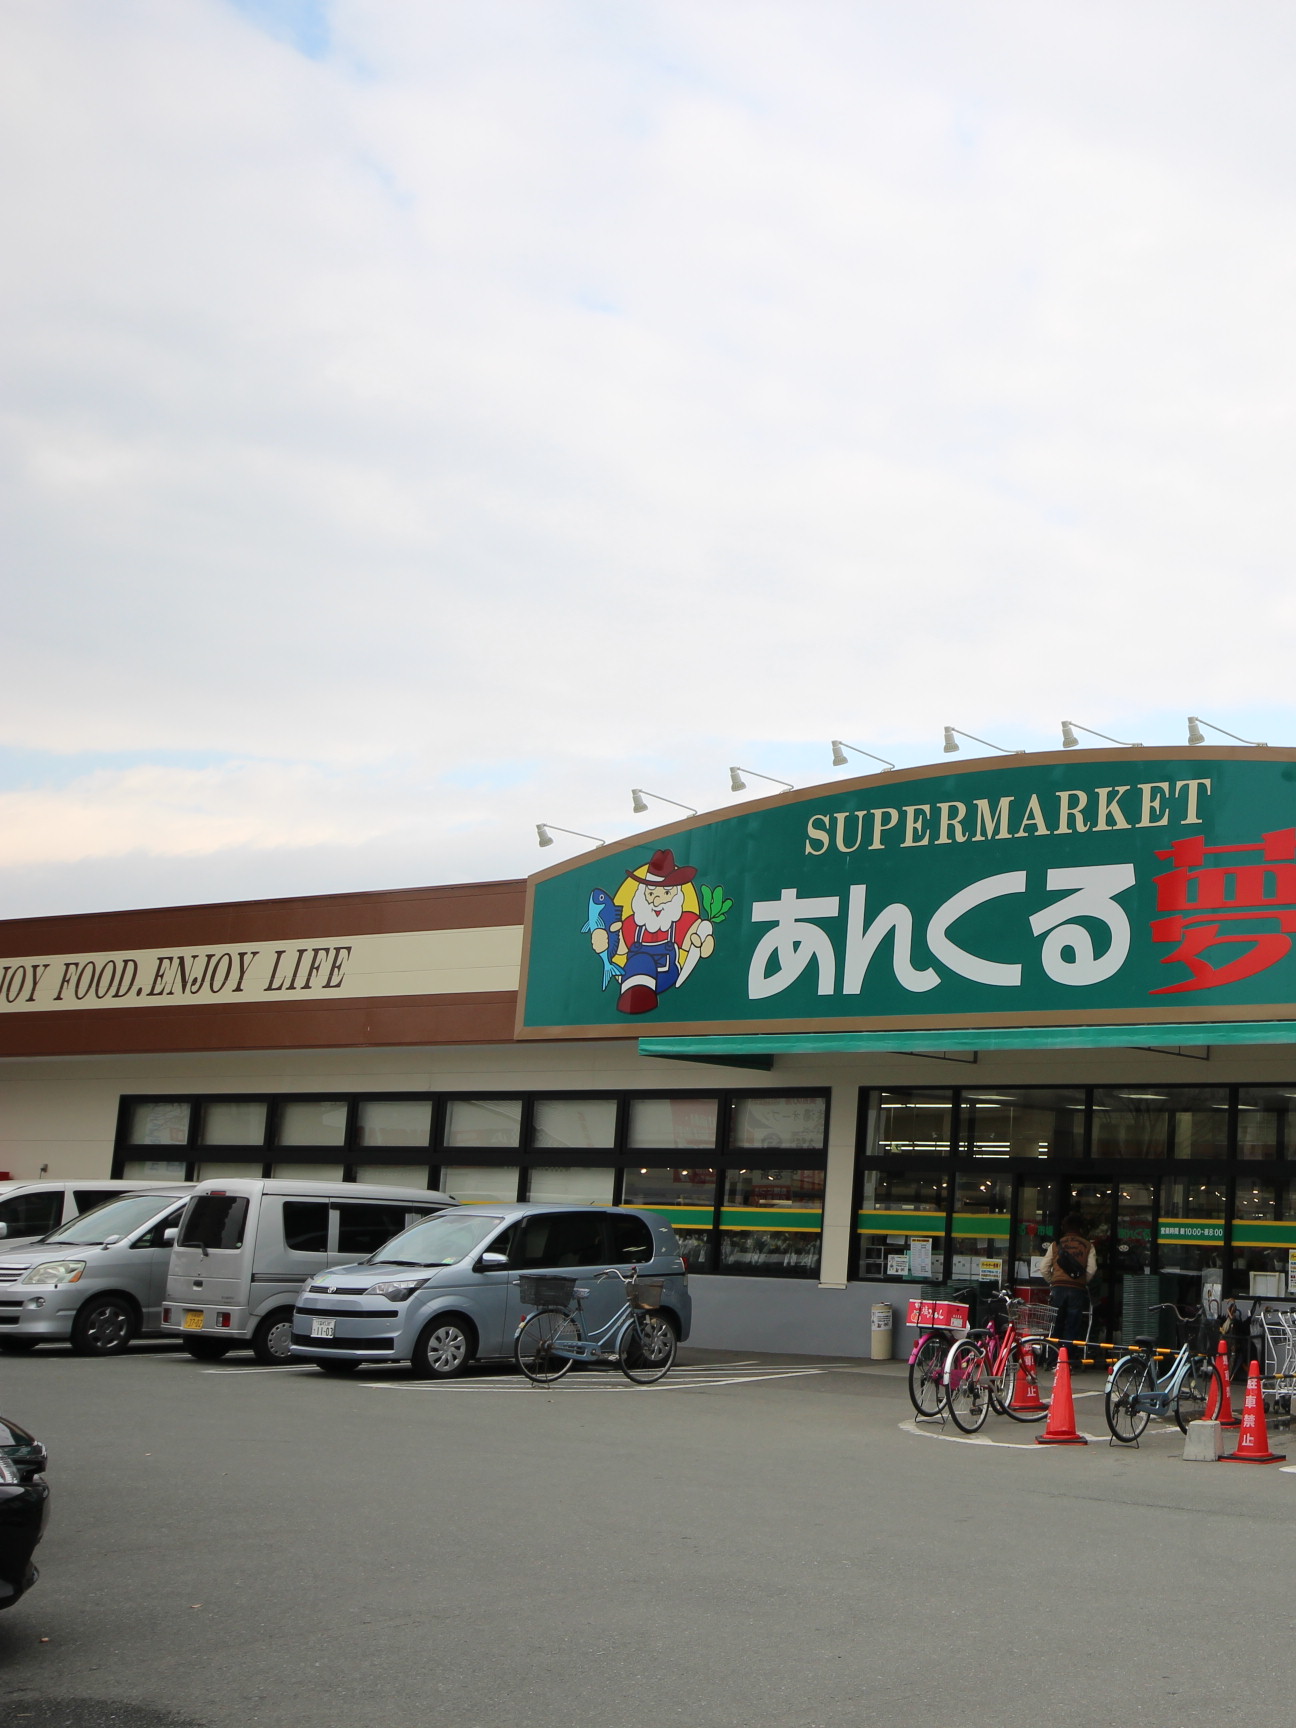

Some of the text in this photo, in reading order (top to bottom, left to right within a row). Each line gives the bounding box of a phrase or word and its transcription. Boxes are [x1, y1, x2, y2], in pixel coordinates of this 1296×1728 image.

[805, 778, 1211, 855] SUPERMARKET
[263, 945, 353, 992] LIFE
[1241, 1378, 1258, 1446] 駐車禁止
